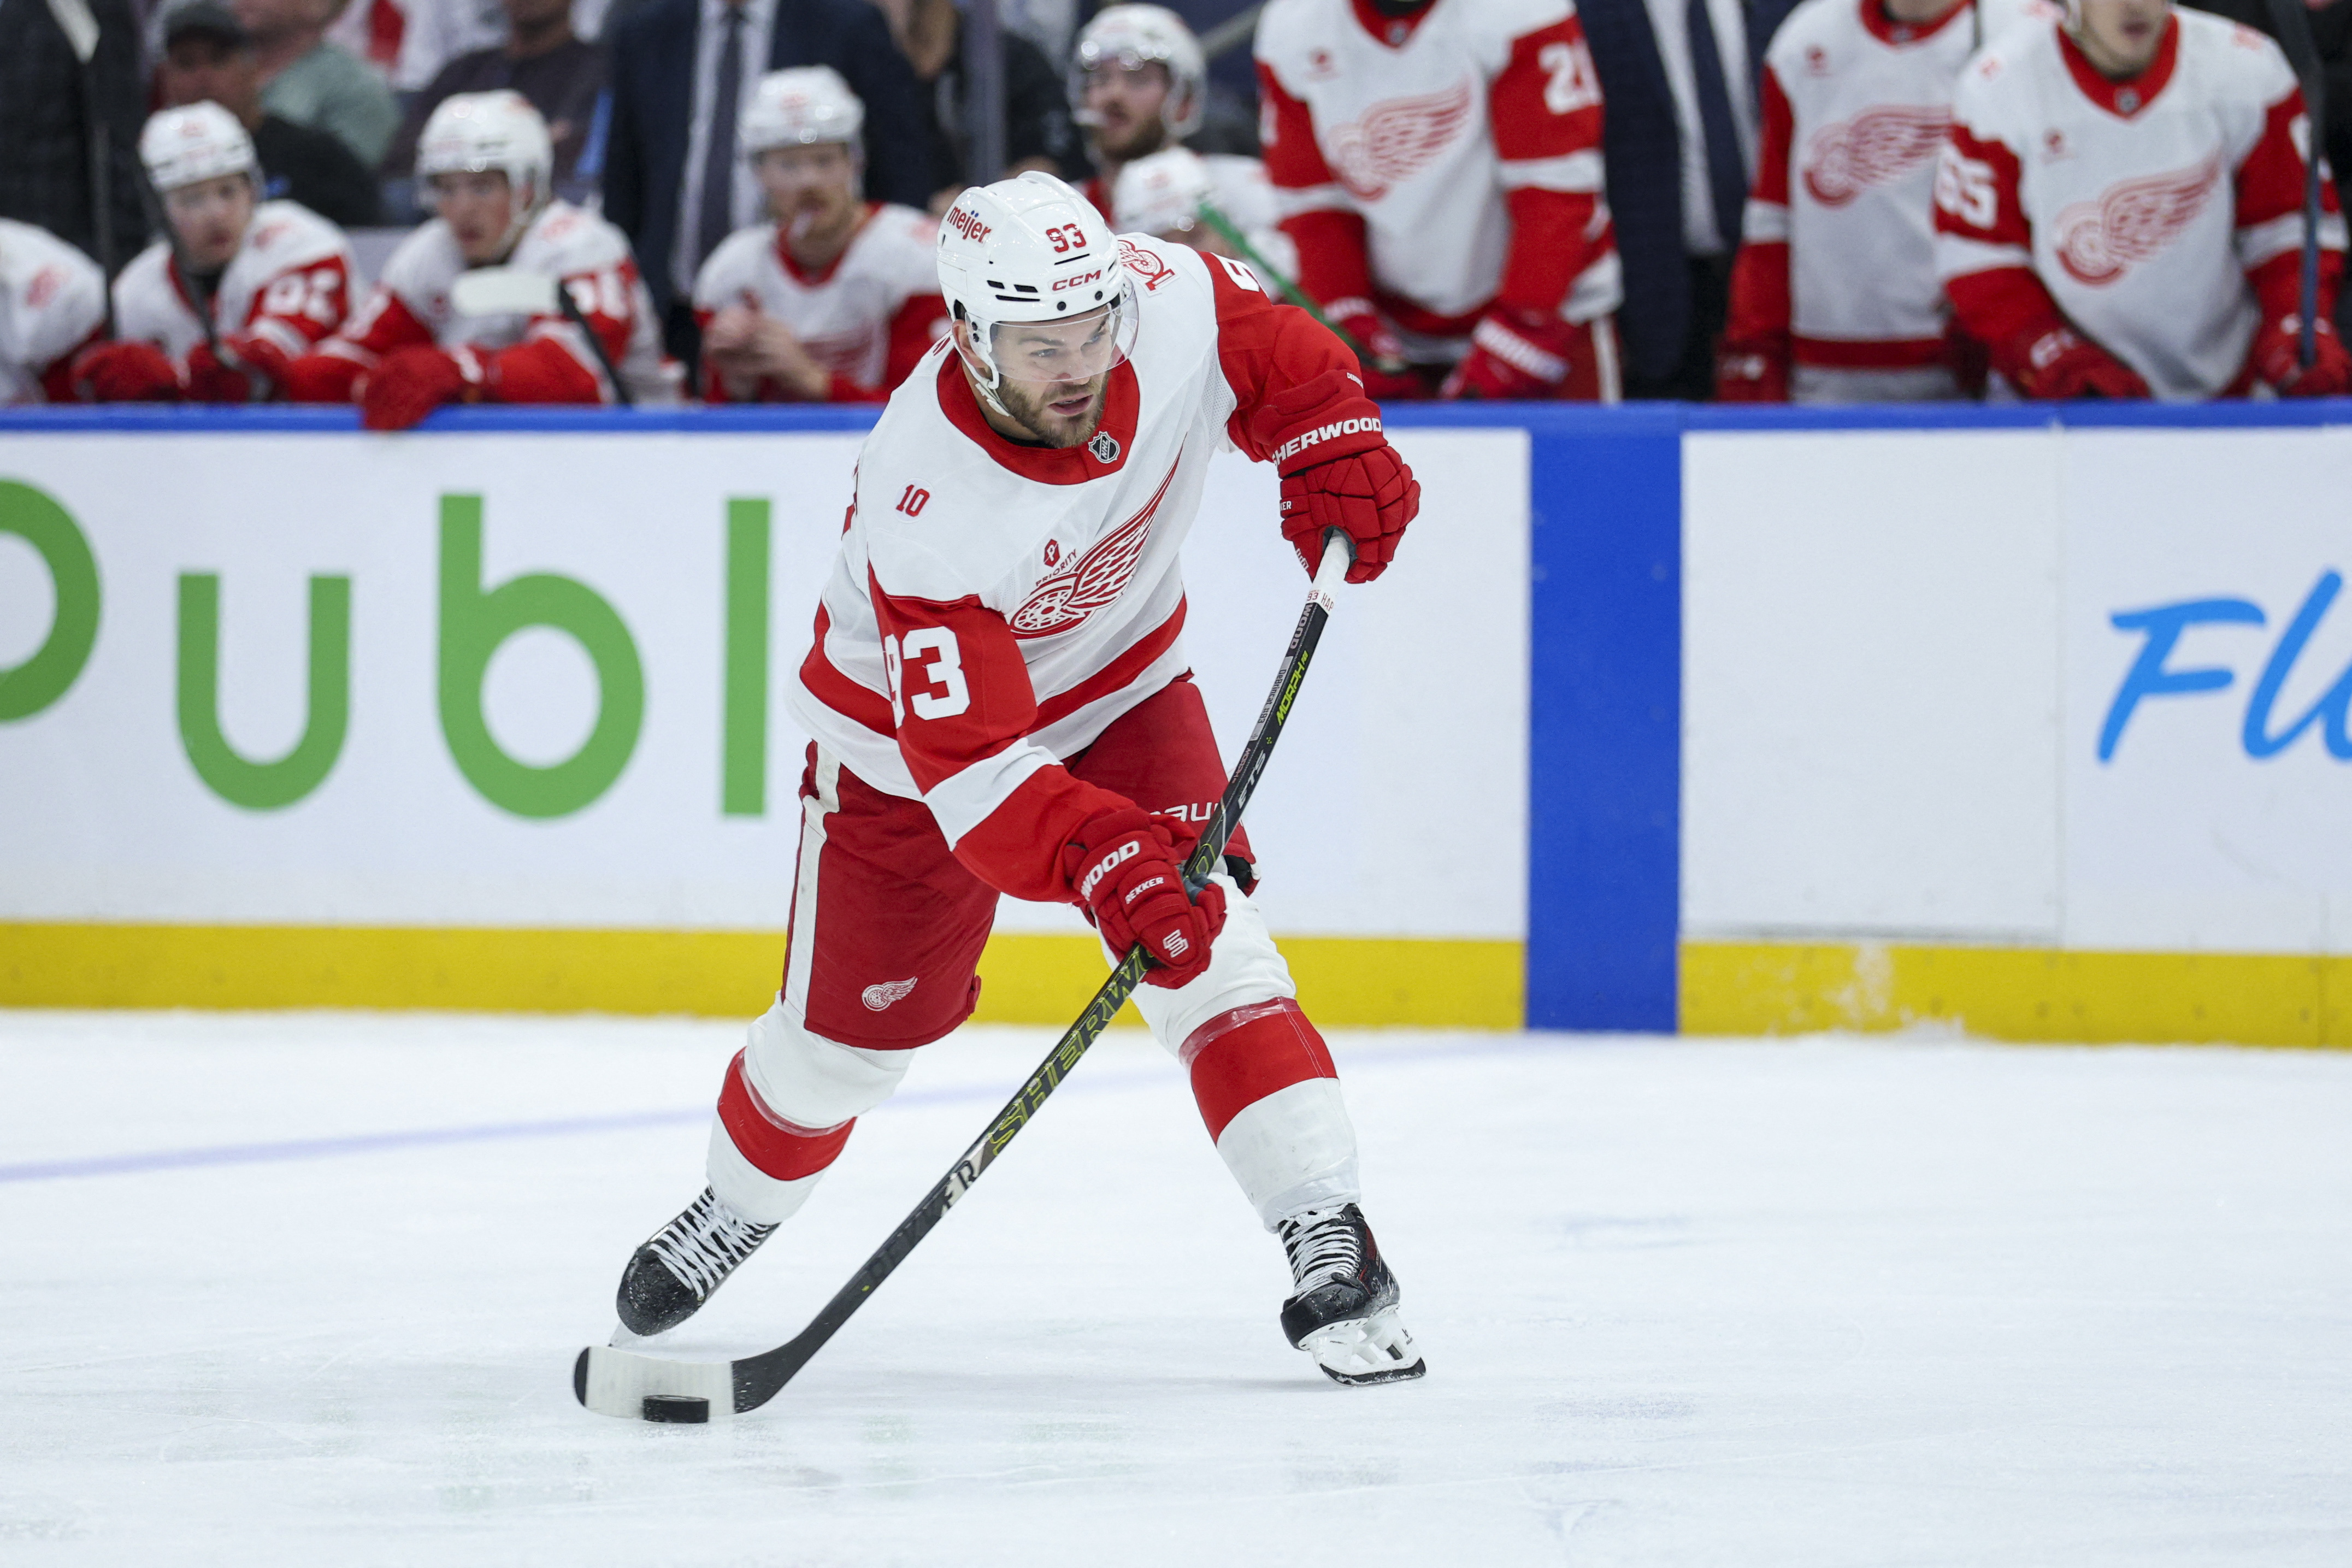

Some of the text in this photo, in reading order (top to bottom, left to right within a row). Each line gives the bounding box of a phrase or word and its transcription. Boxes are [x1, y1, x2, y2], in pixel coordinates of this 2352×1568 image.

[947, 205, 992, 244] meijer
[1046, 223, 1087, 253] 93
[1052, 270, 1101, 292] CCM
[895, 484, 930, 517] 10
[1035, 549, 1076, 587] PRIORITY
[884, 626, 971, 730] 93
[1265, 669, 1286, 705] DeBrincat
[1276, 661, 1305, 727] MORPH
[1237, 748, 1266, 809] ETS
[1125, 876, 1164, 905] REKKER
